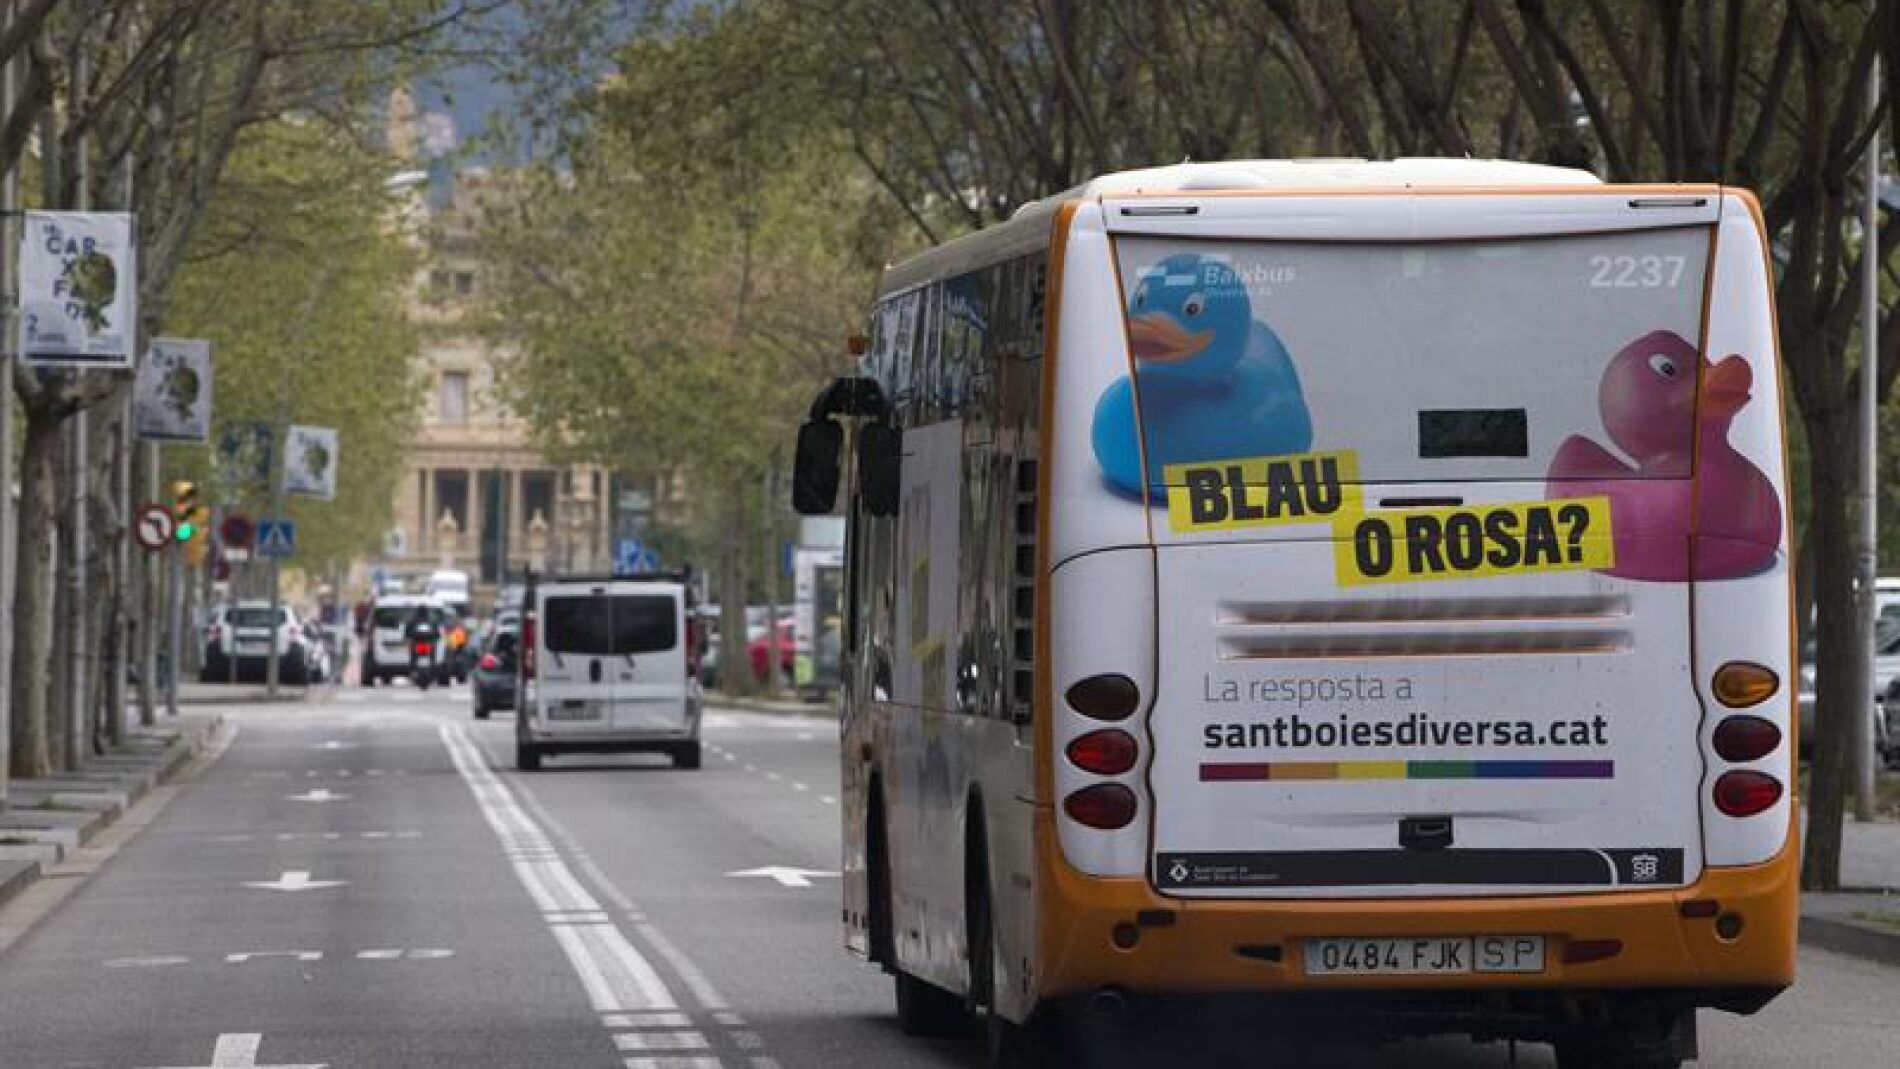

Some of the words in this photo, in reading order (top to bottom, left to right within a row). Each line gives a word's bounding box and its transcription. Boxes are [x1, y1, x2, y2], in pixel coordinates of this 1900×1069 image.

[1589, 254, 1685, 288] 2237
[1185, 457, 1342, 525] BLAU
[1355, 518, 1393, 577] O
[1405, 504, 1590, 574] ROSA?
[1204, 674, 1239, 702] La
[1249, 673, 1386, 708] resposta
[1399, 679, 1414, 700] a
[1203, 713, 1608, 749] santboiesdiversa.cat
[1322, 941, 1400, 970] 0484
[1412, 941, 1463, 970] FJK
